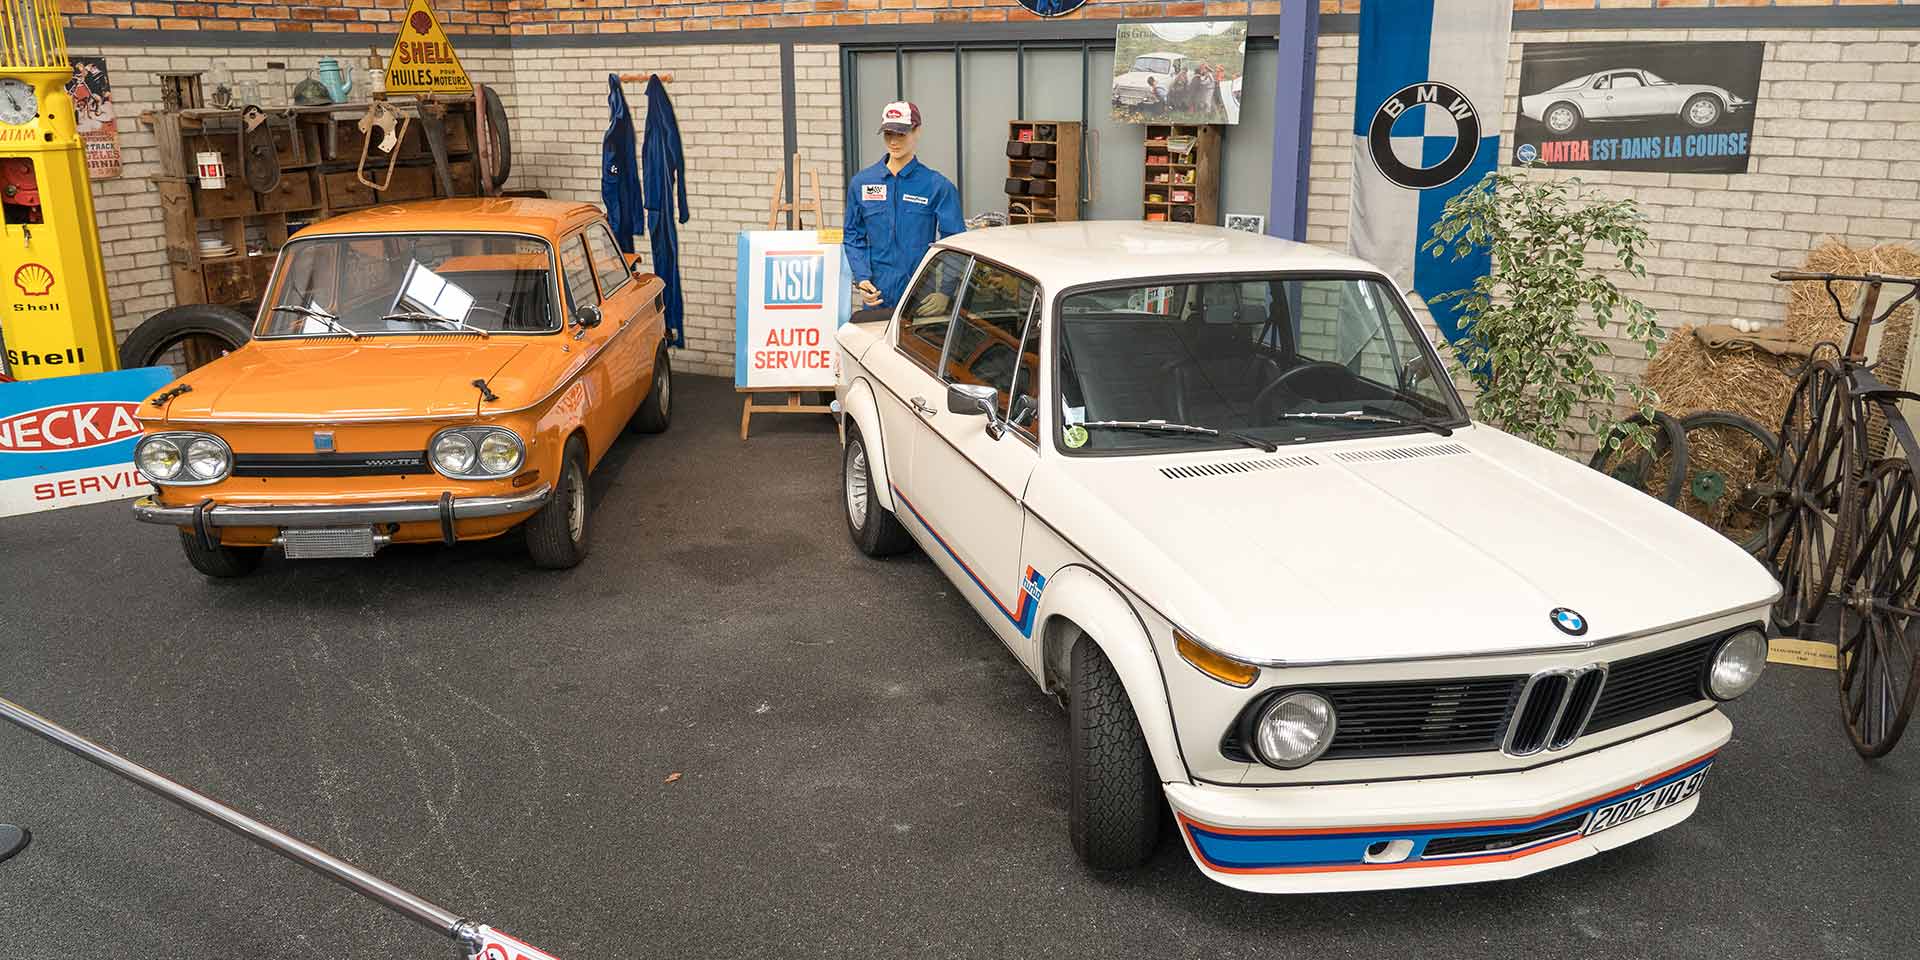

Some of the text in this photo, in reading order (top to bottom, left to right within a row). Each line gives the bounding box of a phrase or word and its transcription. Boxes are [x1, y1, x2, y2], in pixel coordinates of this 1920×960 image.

[399, 41, 453, 64] SHELL
[391, 70, 433, 86] HUILES
[434, 76, 467, 86] MOTEURS
[1382, 85, 1473, 121] BMW
[1541, 132, 1748, 162] MATRA EST DANS LA COURSE
[771, 258, 820, 301] NSU
[13, 303, 60, 312] Shell
[766, 328, 820, 347] AUTO
[8, 347, 85, 366] Shell
[754, 350, 831, 369] SERVICE
[0, 406, 144, 448] NECKA
[34, 470, 151, 501] SERVIC
[1023, 576, 1043, 602] turbo
[1589, 791, 1656, 833] 2002
[1681, 765, 1711, 799] 91
